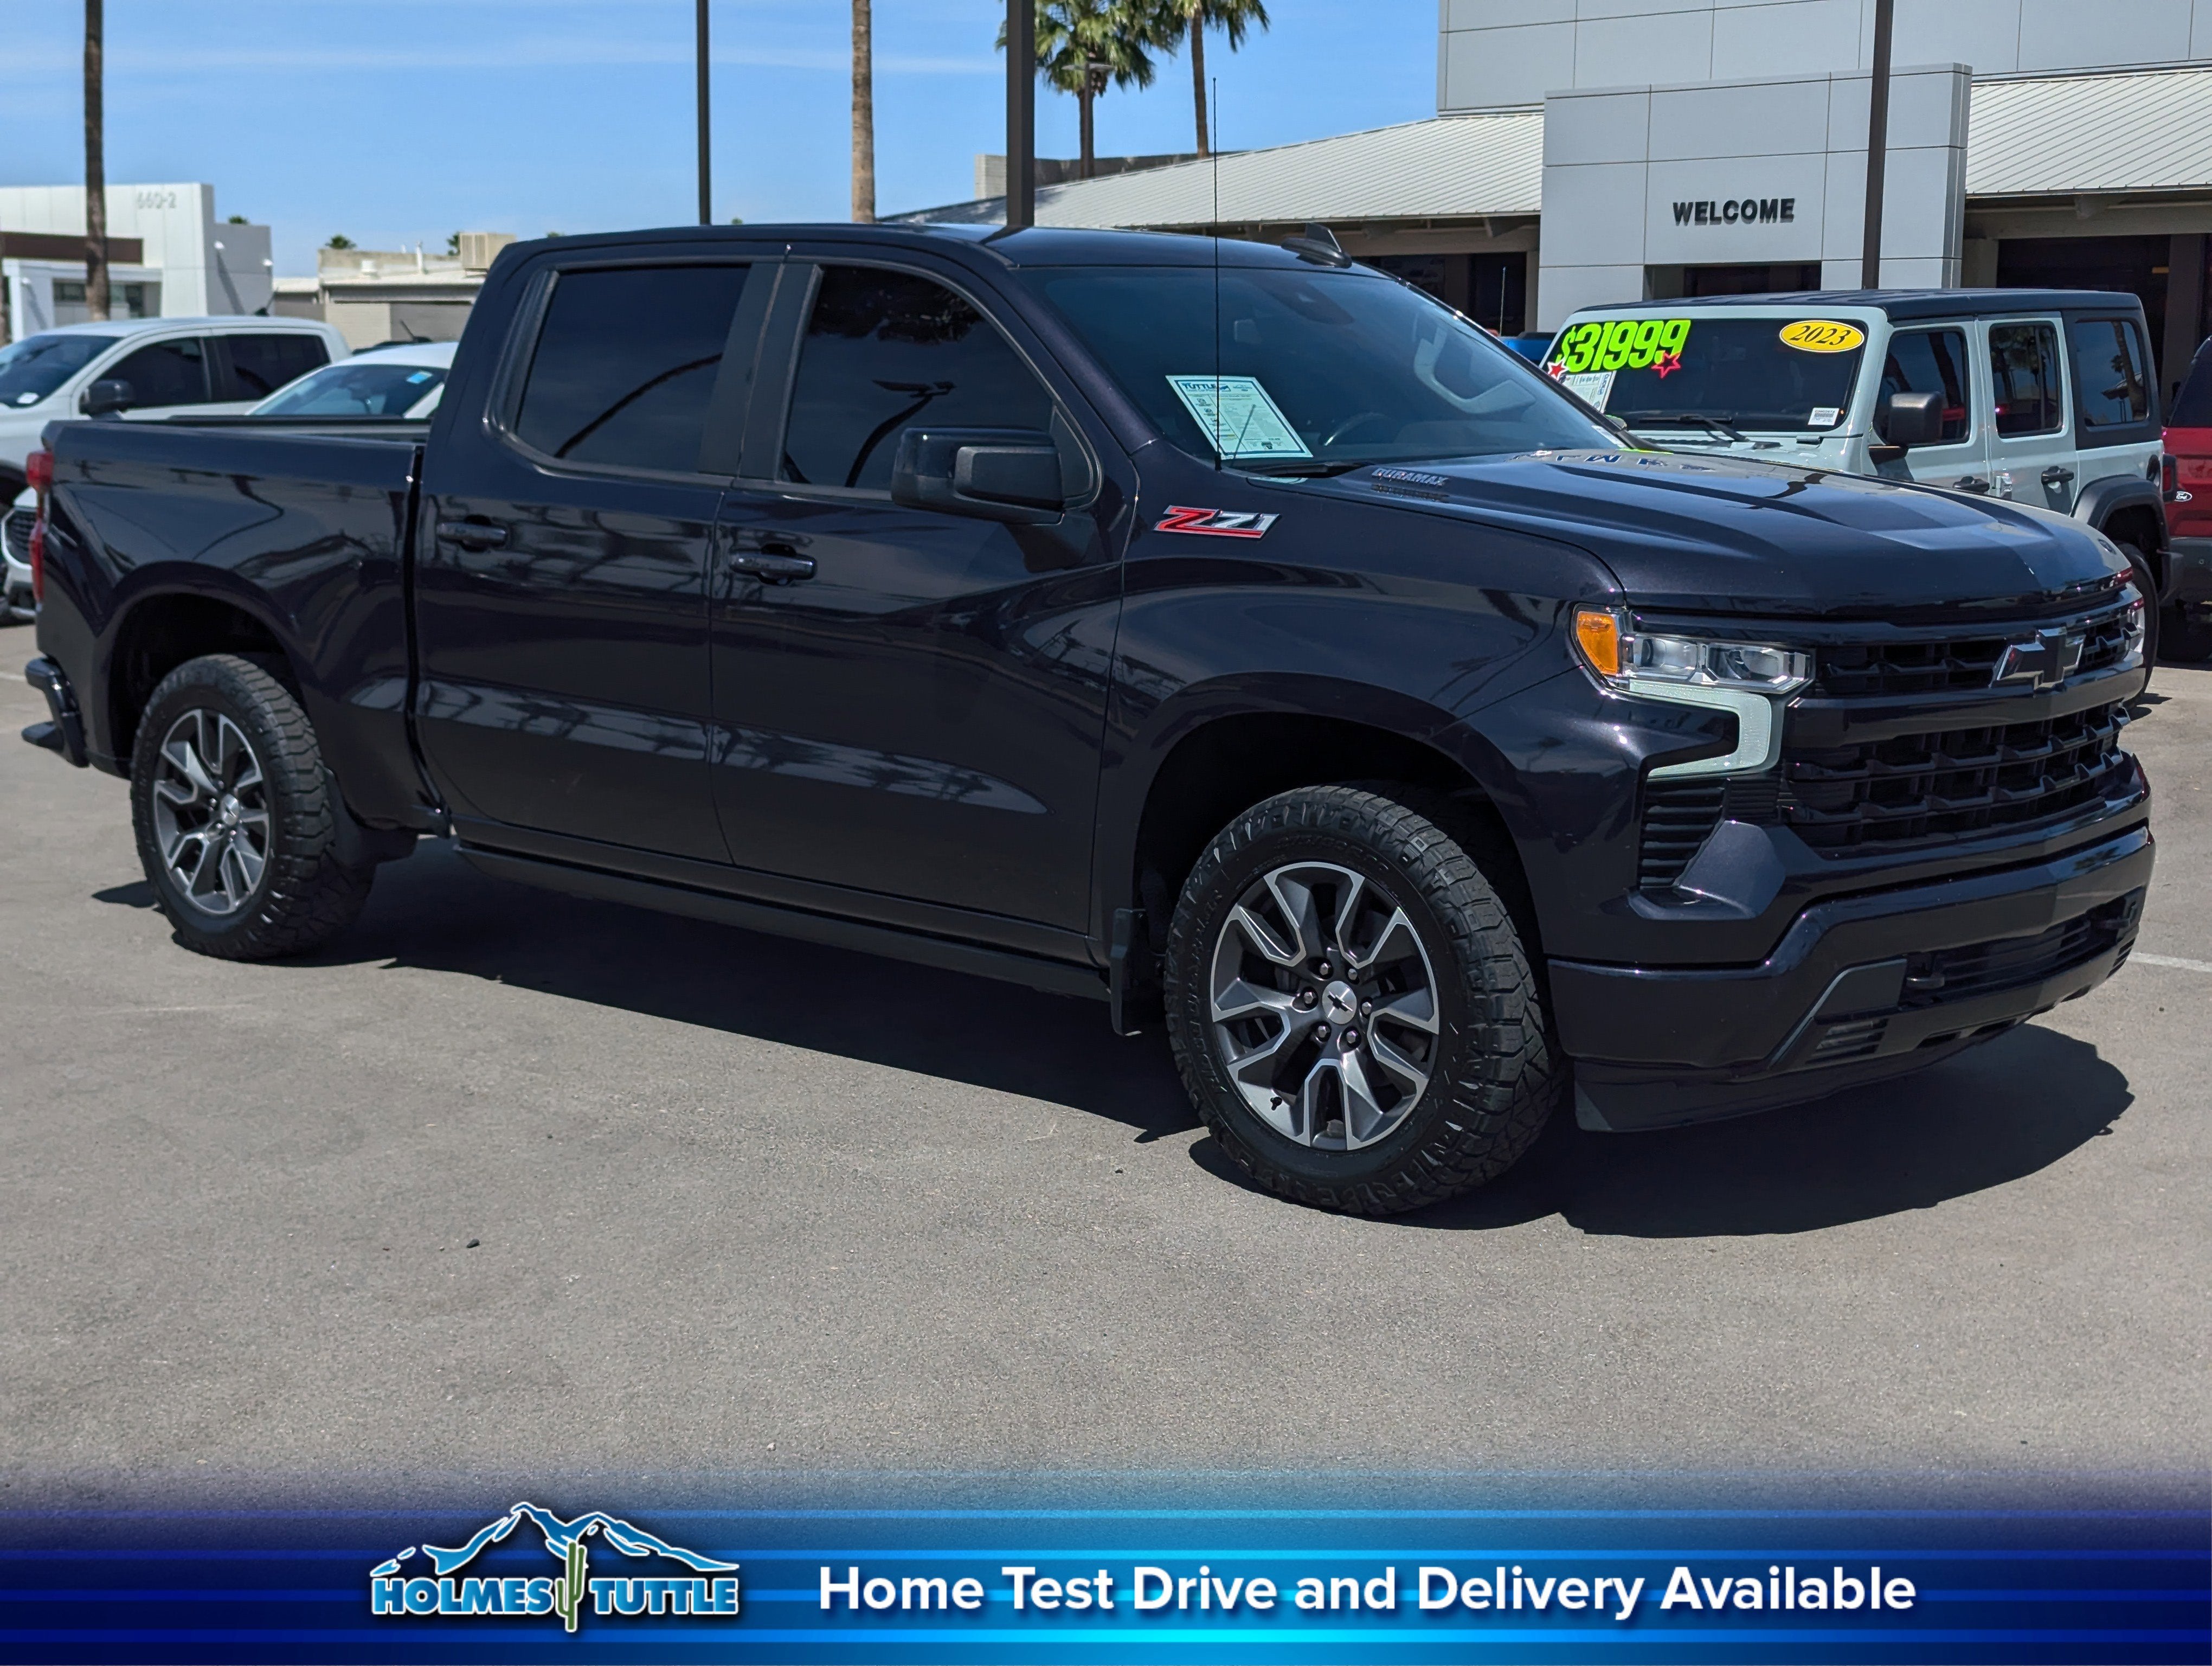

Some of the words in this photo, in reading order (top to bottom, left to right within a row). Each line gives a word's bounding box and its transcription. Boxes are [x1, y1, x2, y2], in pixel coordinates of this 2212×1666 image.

[1673, 198, 1795, 226] WELCOME
[1555, 319, 1691, 373] $31999
[1789, 325, 1852, 345] 2023
[1371, 467, 1449, 486] DURAMAX
[1153, 505, 1280, 539] Z71
